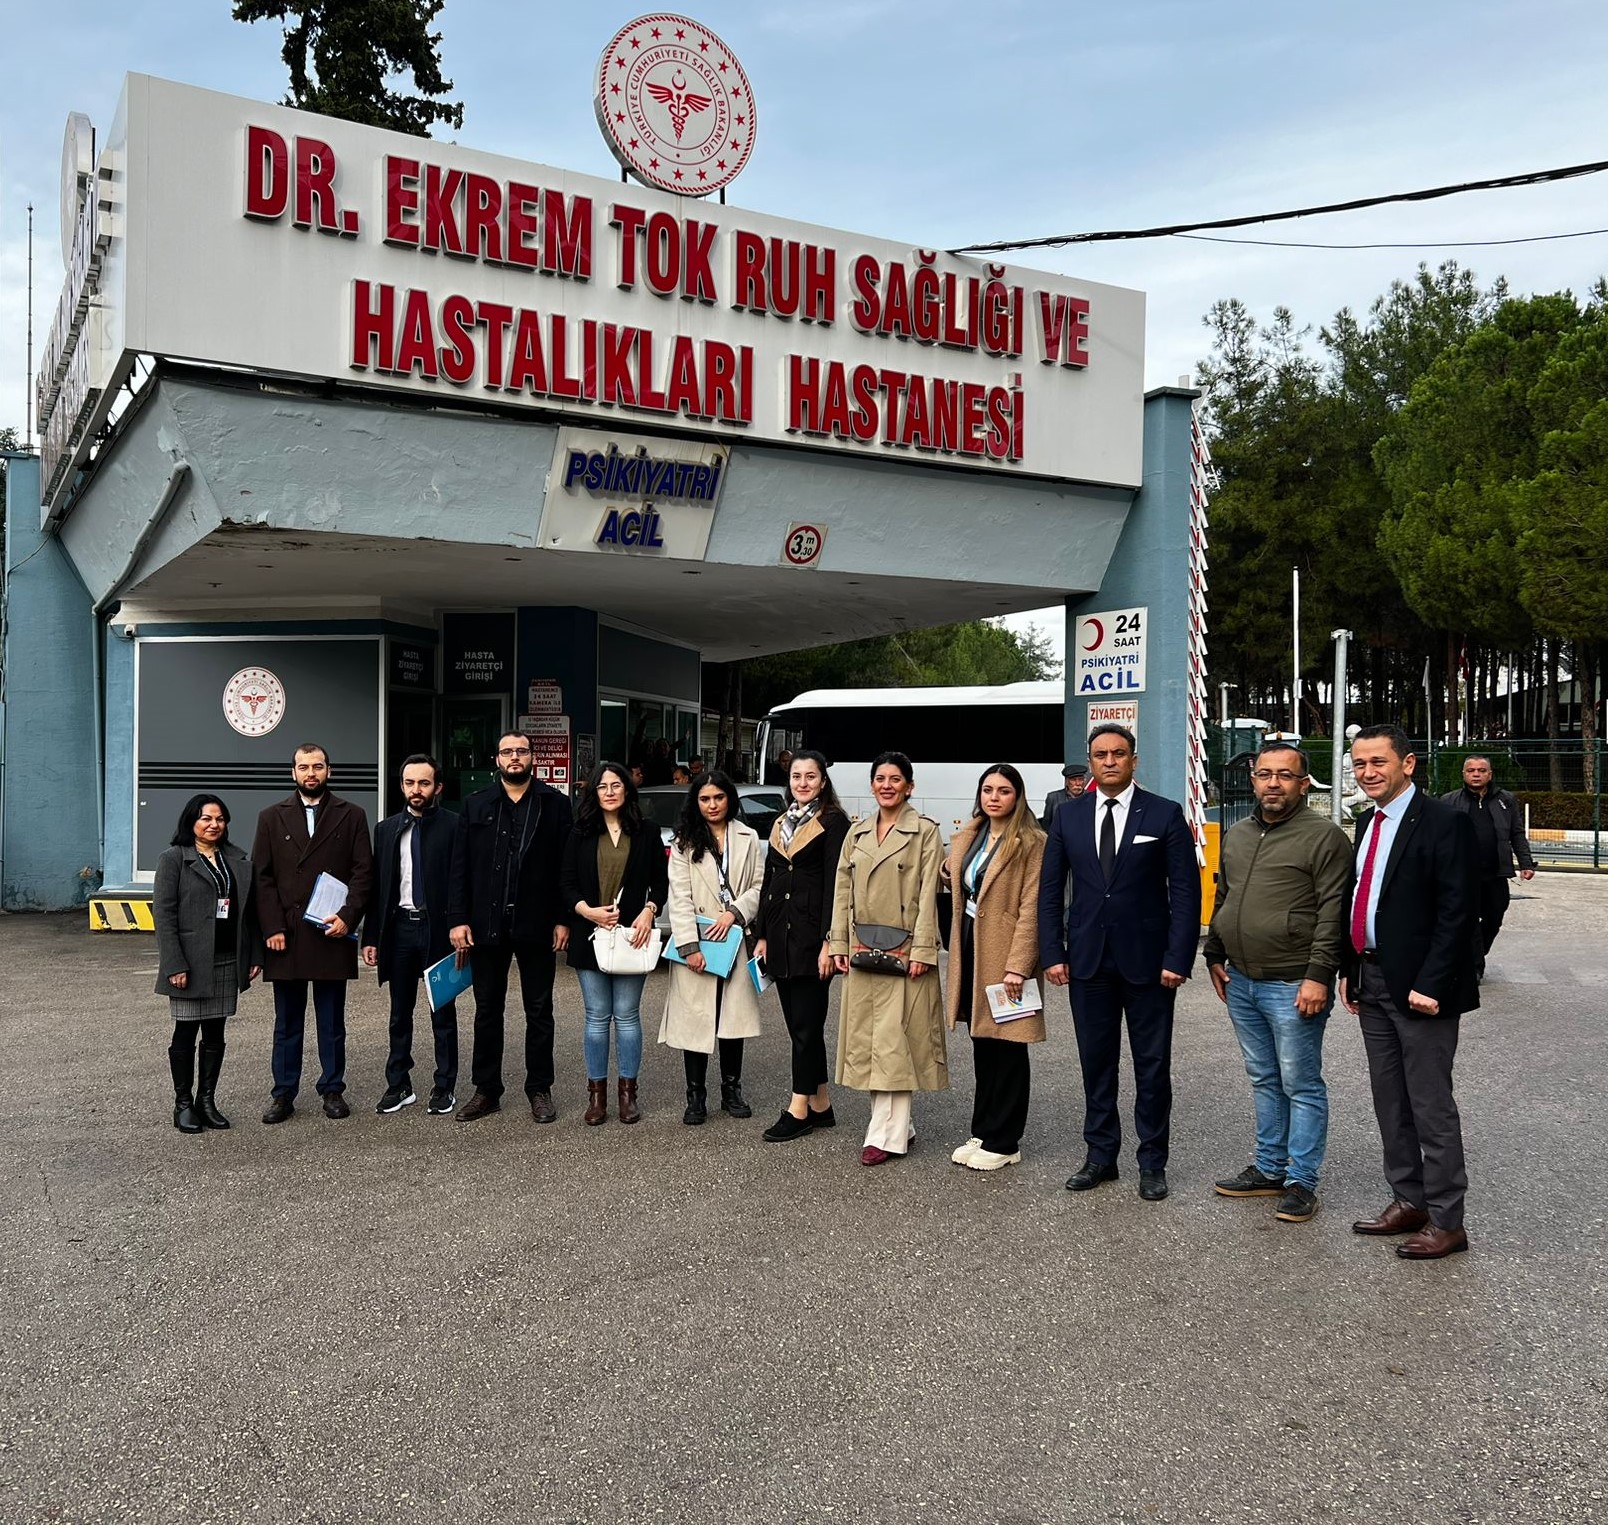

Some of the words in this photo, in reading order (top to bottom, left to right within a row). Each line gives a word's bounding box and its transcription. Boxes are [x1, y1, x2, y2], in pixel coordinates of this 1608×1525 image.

[630, 48, 689, 90] CUMHURİYETİ
[691, 58, 721, 96] SAĞLIK
[630, 95, 657, 146] TÜRKİYE
[700, 100, 726, 157] BAKANLIĞI
[245, 125, 359, 235] DR.
[385, 154, 592, 279] EKREM
[610, 204, 718, 302] TOK
[733, 230, 836, 324] RUH
[851, 249, 1023, 356] SAĞLIĞI
[1035, 290, 1089, 367] VE
[352, 280, 753, 423] HASTALIKLARI
[787, 354, 1023, 461] HASTANESİ
[564, 442, 722, 500] PSİKİYATRİ
[596, 501, 663, 548] ACİL
[1115, 613, 1140, 633] 24
[464, 651, 495, 659] HASTA
[1114, 636, 1141, 647] SAAT
[454, 660, 503, 671] ZİYARETÇİ
[1081, 651, 1139, 668] PSİKİYATRİ
[464, 671, 493, 681] GİRİŞİ
[1080, 667, 1140, 691] ACİL
[1090, 705, 1136, 722] ZİYARETÇİ
